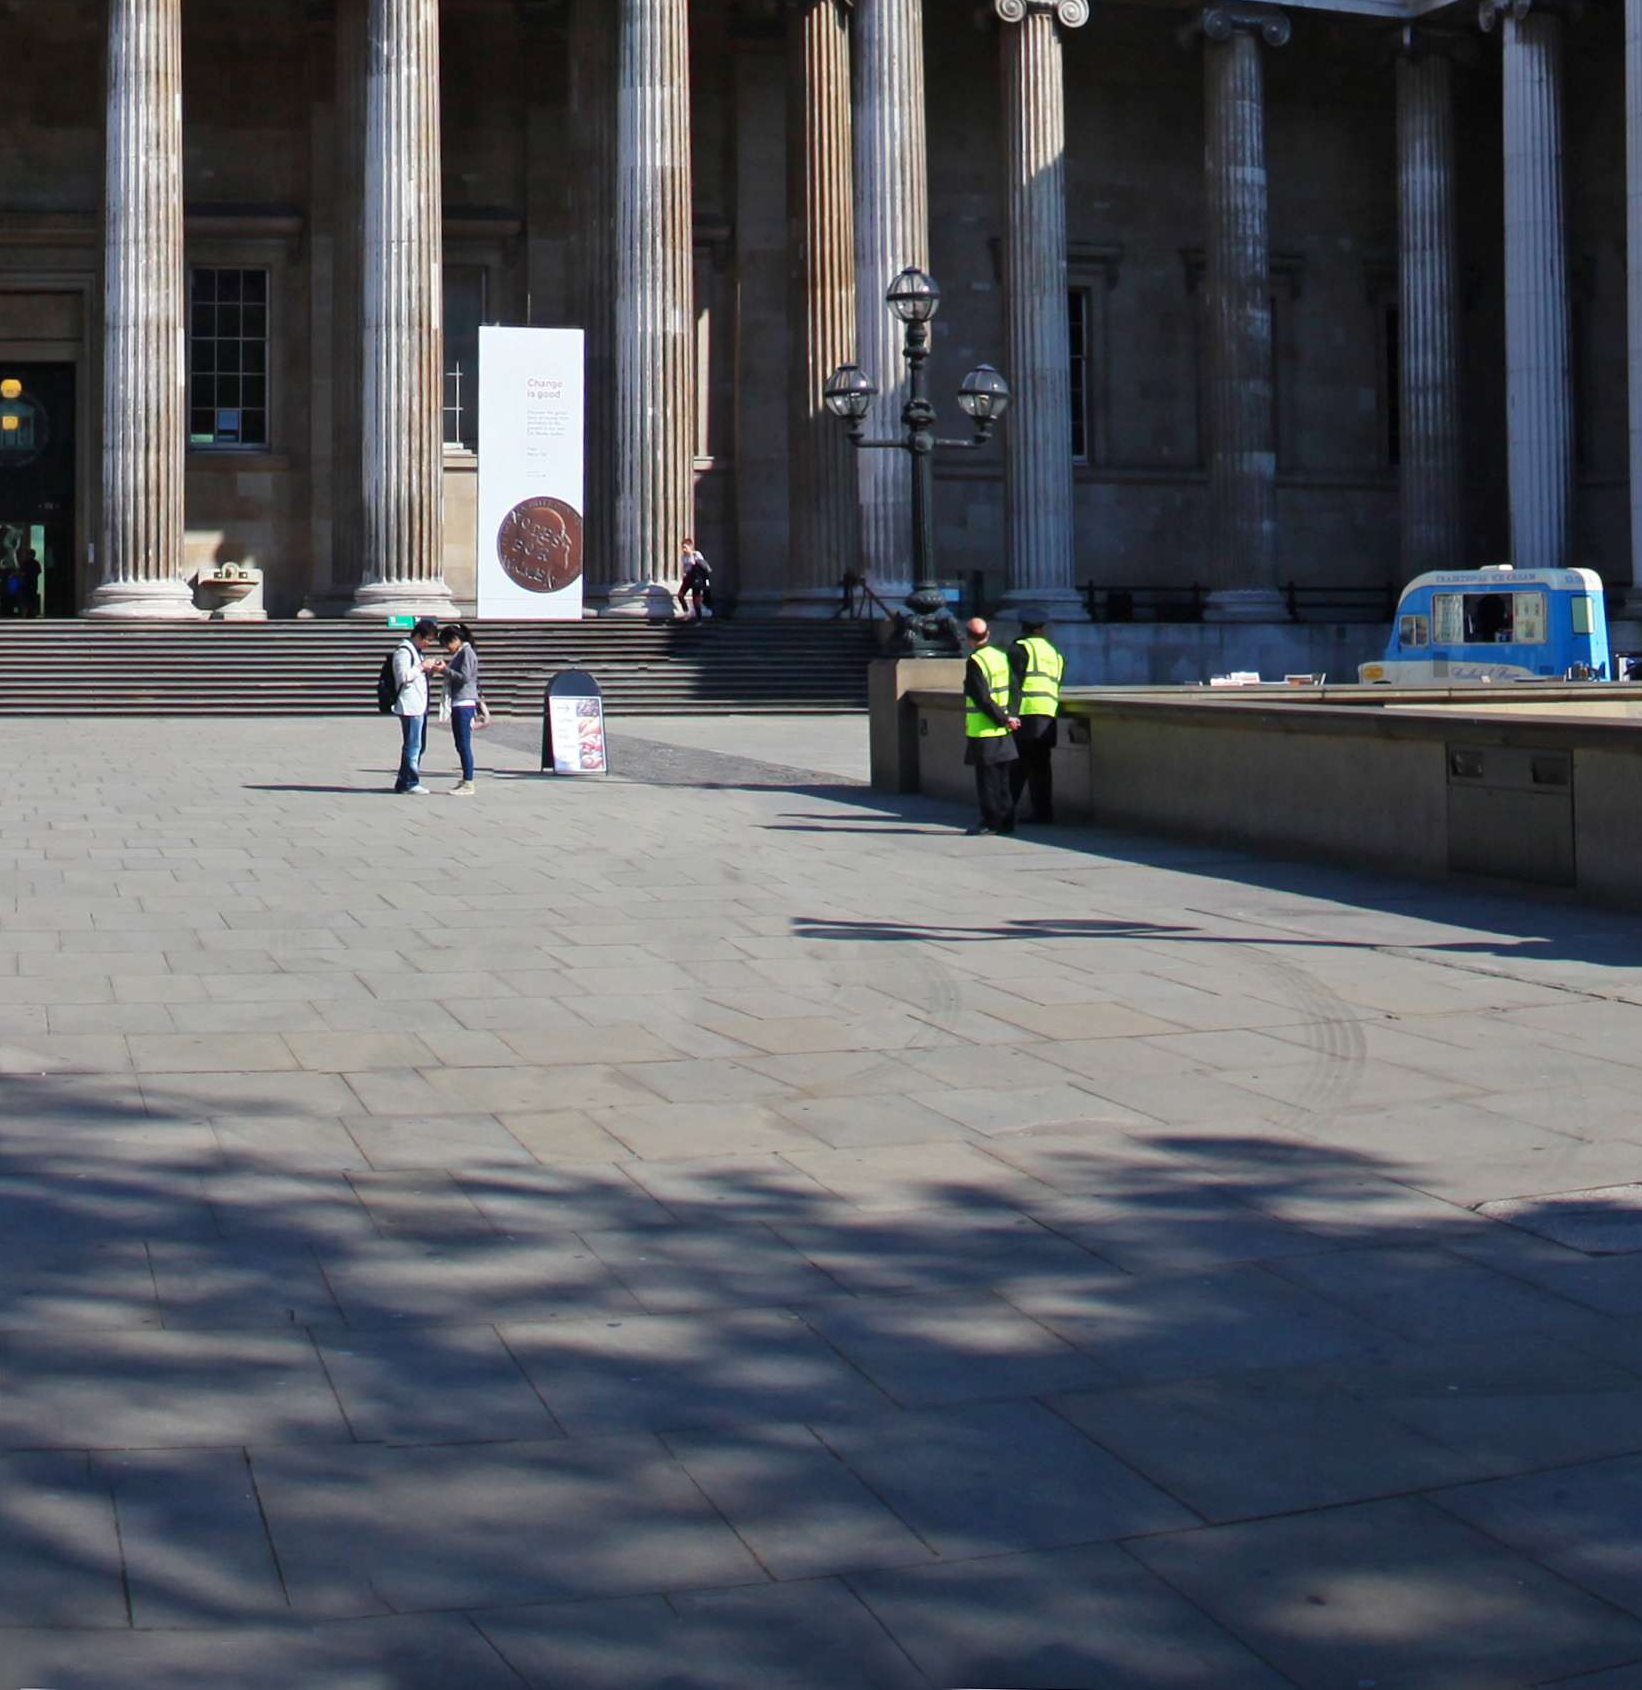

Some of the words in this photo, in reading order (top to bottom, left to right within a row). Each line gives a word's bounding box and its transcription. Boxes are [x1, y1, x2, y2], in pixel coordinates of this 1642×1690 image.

[526, 378, 563, 389] Change
[526, 390, 535, 398] is
[537, 390, 561, 399] good
